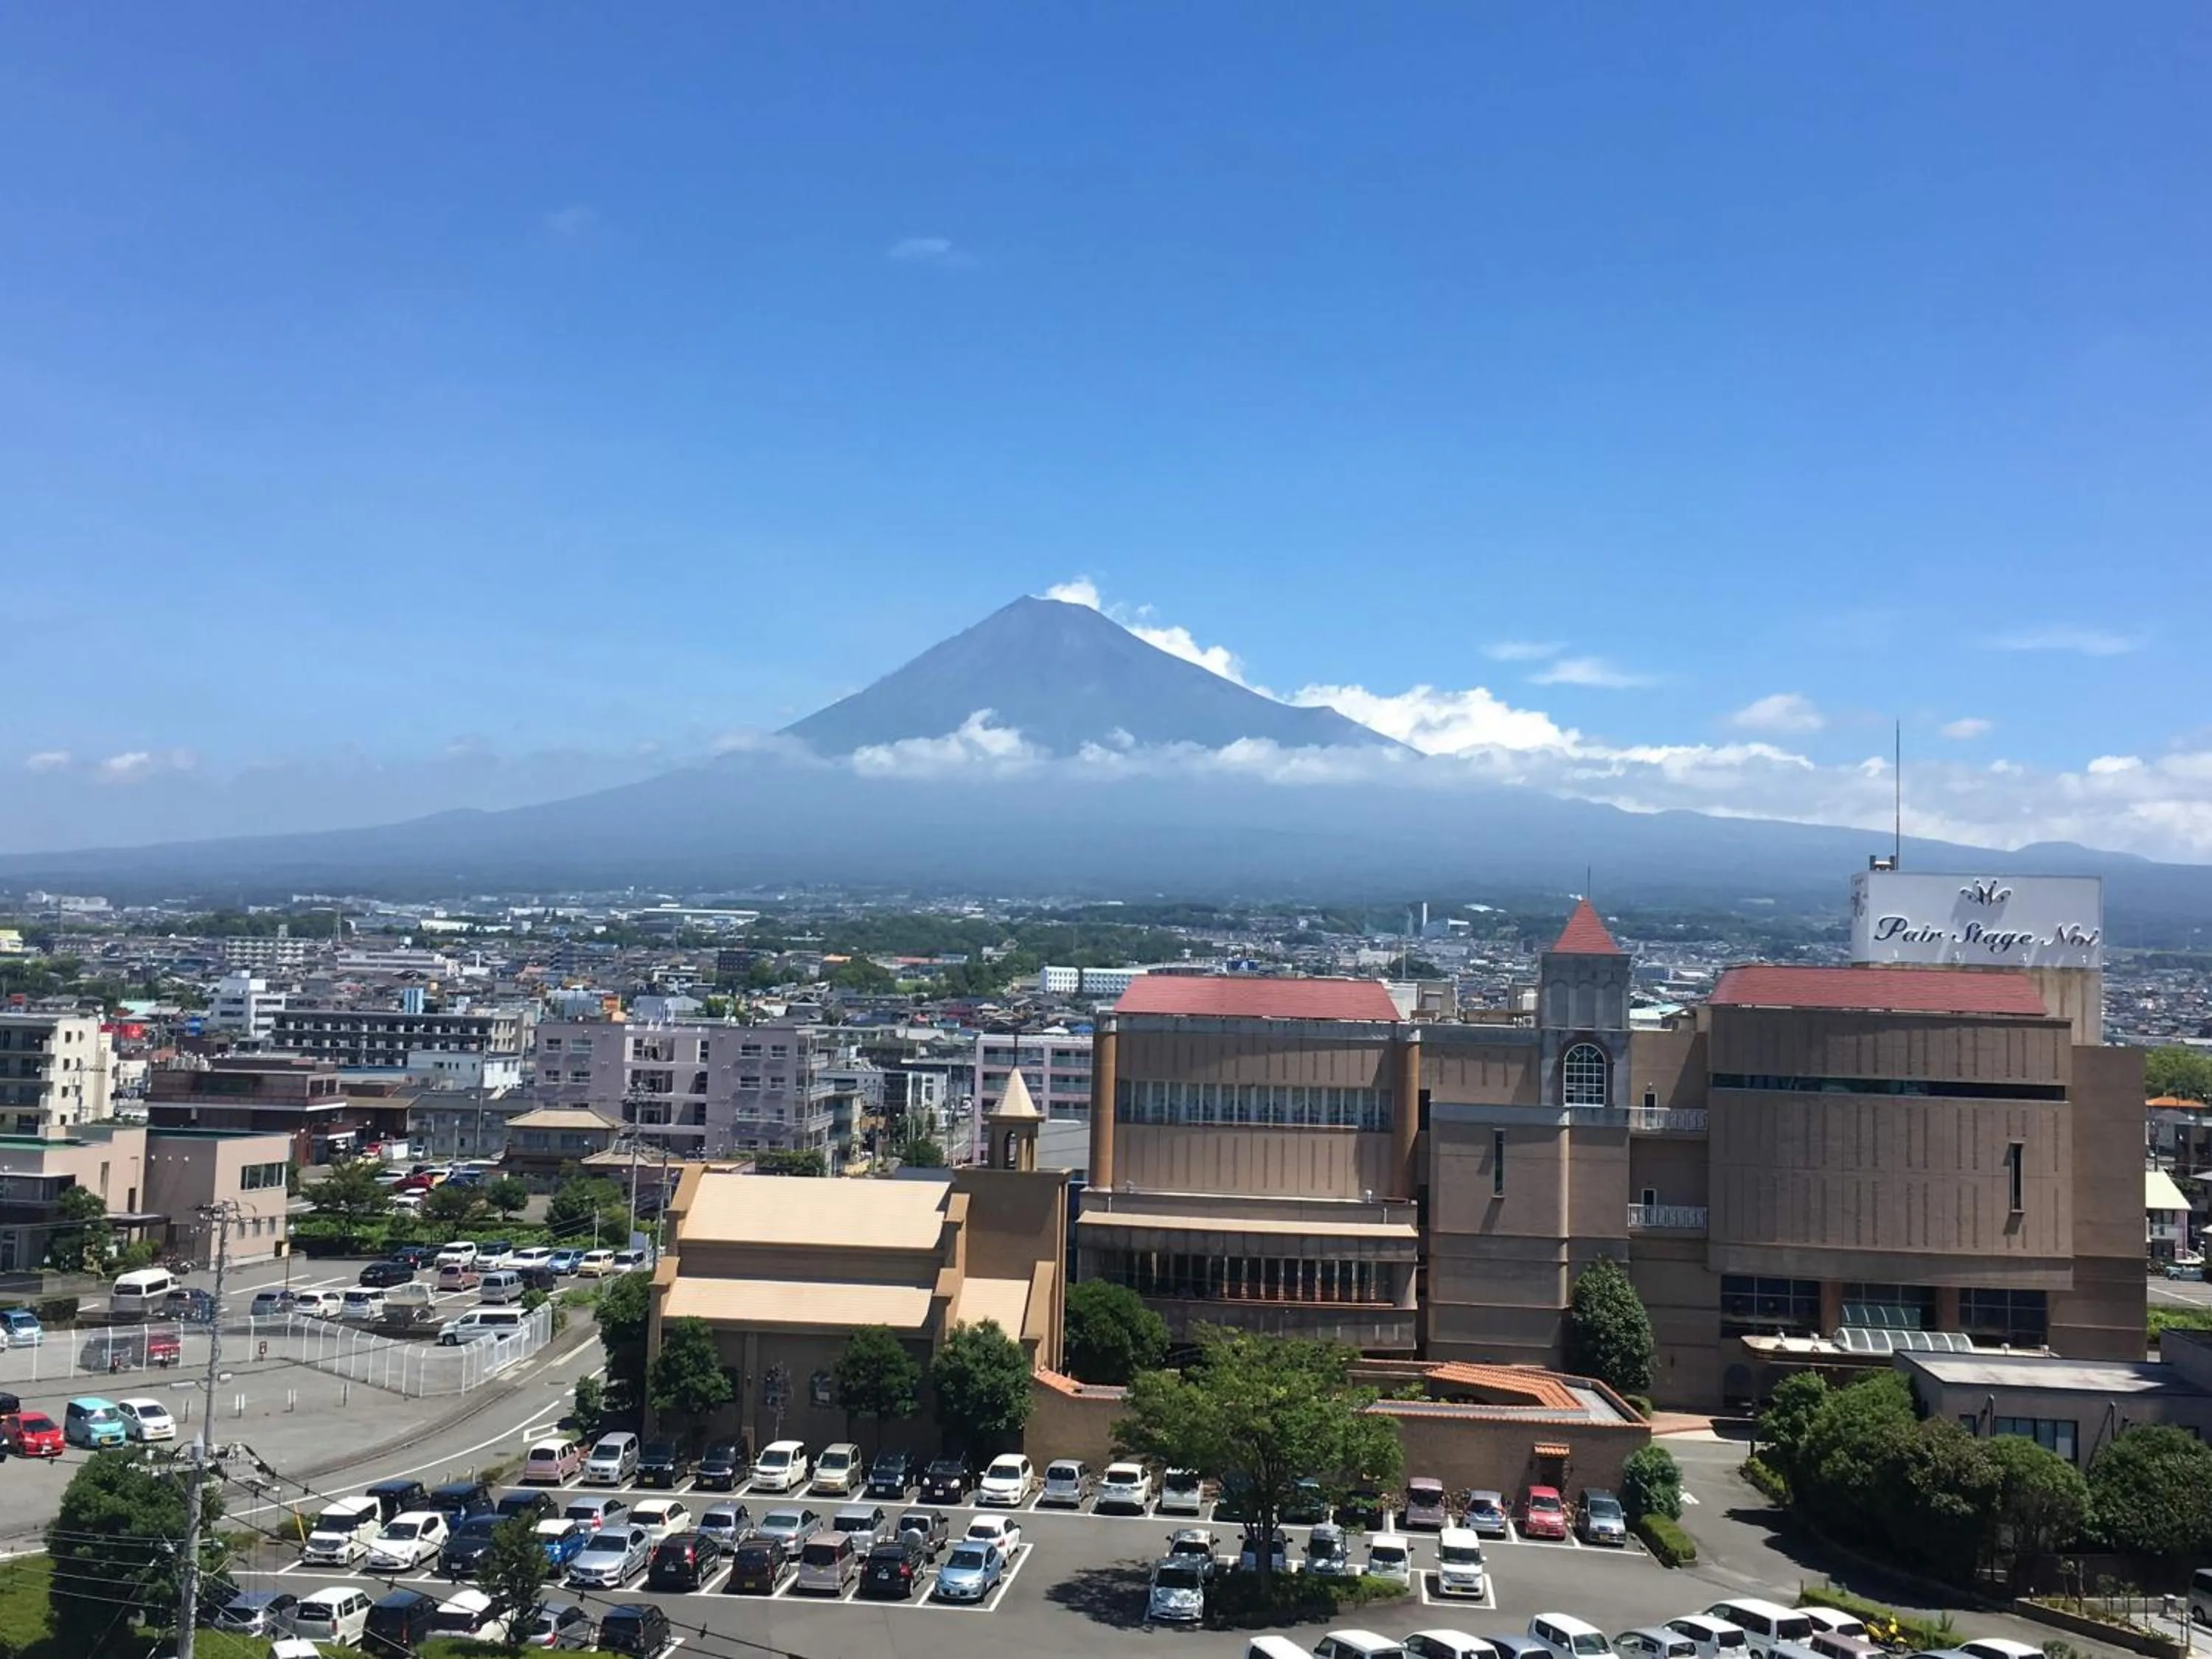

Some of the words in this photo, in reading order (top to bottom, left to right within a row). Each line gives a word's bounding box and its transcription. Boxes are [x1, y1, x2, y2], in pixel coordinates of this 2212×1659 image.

[1874, 916, 1945, 943] Pair
[1951, 921, 2035, 954] Stage
[2040, 923, 2100, 947] Noi
